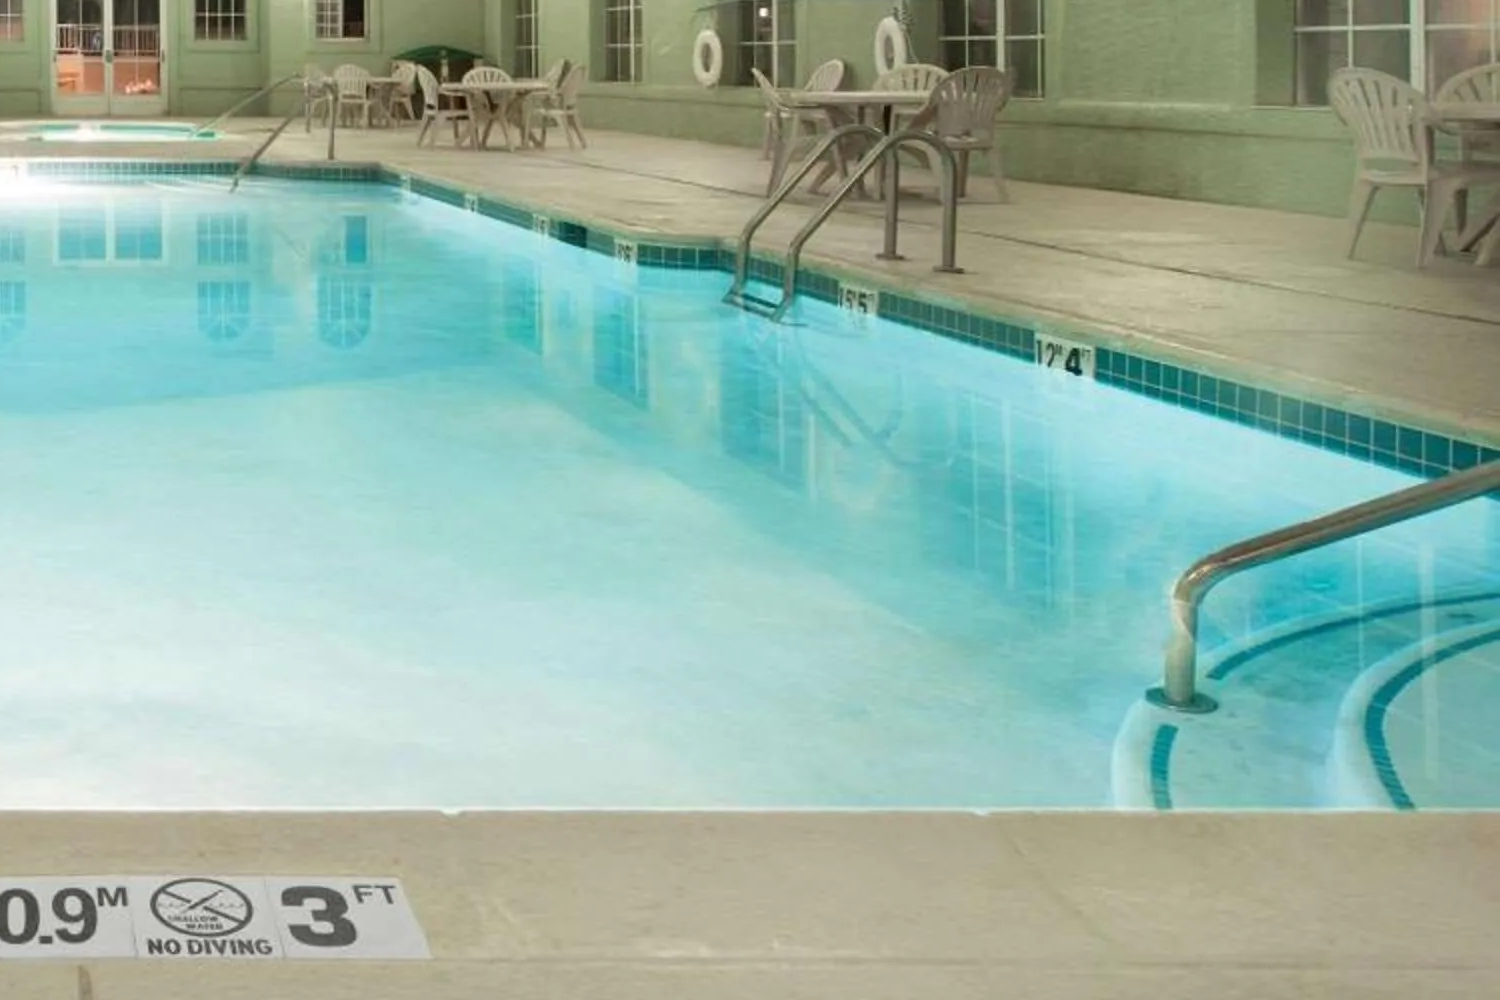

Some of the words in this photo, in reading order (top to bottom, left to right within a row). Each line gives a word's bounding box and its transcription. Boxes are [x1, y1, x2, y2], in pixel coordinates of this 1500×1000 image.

[1065, 347, 1083, 376] 4
[281, 885, 357, 947] 3
[352, 884, 396, 905] FT
[147, 938, 182, 955] NO
[186, 938, 273, 955] DIVING
